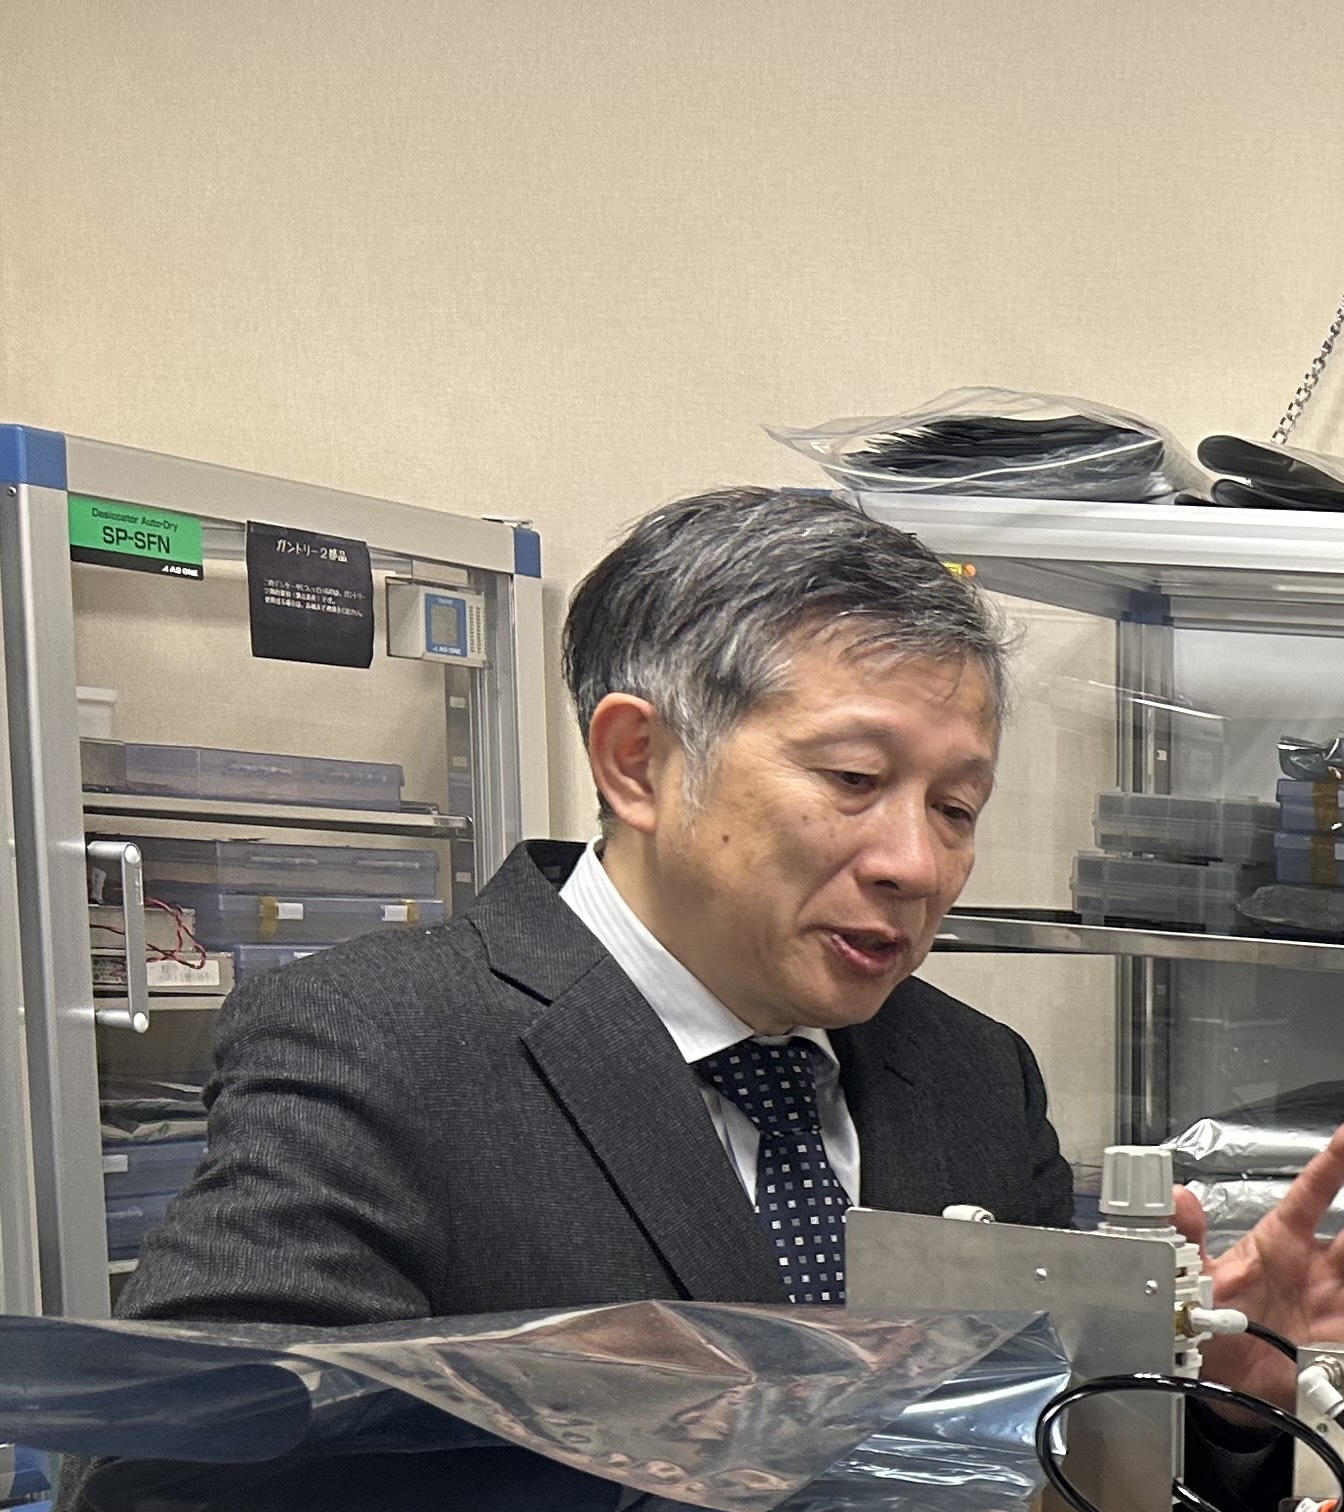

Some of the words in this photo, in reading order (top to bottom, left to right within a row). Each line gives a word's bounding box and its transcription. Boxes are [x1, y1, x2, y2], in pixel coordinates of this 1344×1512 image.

[91, 508, 139, 525] Desiccator
[140, 516, 178, 533] Auto-Dry
[102, 526, 171, 554] SP-SFN
